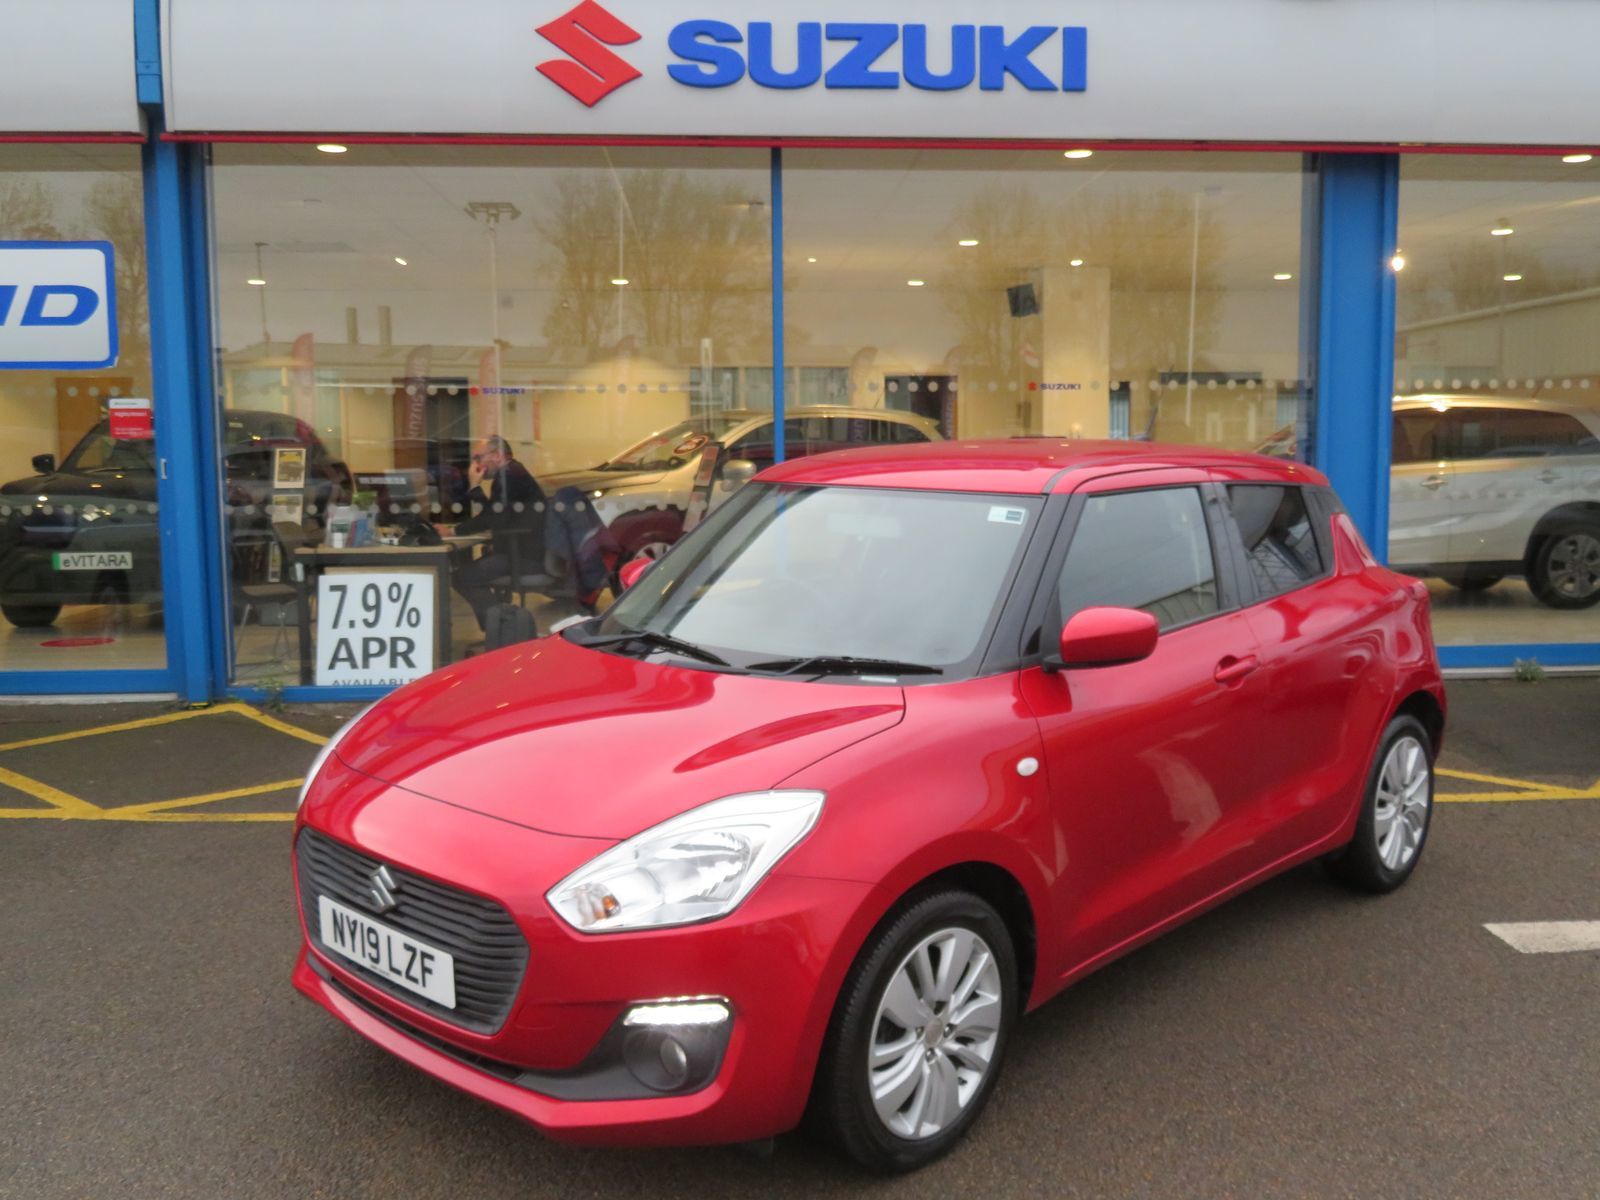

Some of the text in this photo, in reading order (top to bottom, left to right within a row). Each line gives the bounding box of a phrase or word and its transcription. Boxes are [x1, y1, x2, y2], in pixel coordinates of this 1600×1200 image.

[667, 19, 1087, 92] SUZUKI
[482, 387, 525, 395] SUZUKI
[1040, 383, 1081, 391] SUZUKI
[63, 554, 129, 568] eVITARA
[329, 582, 421, 629] 7.9%
[328, 637, 416, 670] APR
[332, 908, 435, 988] NY19 LZF
